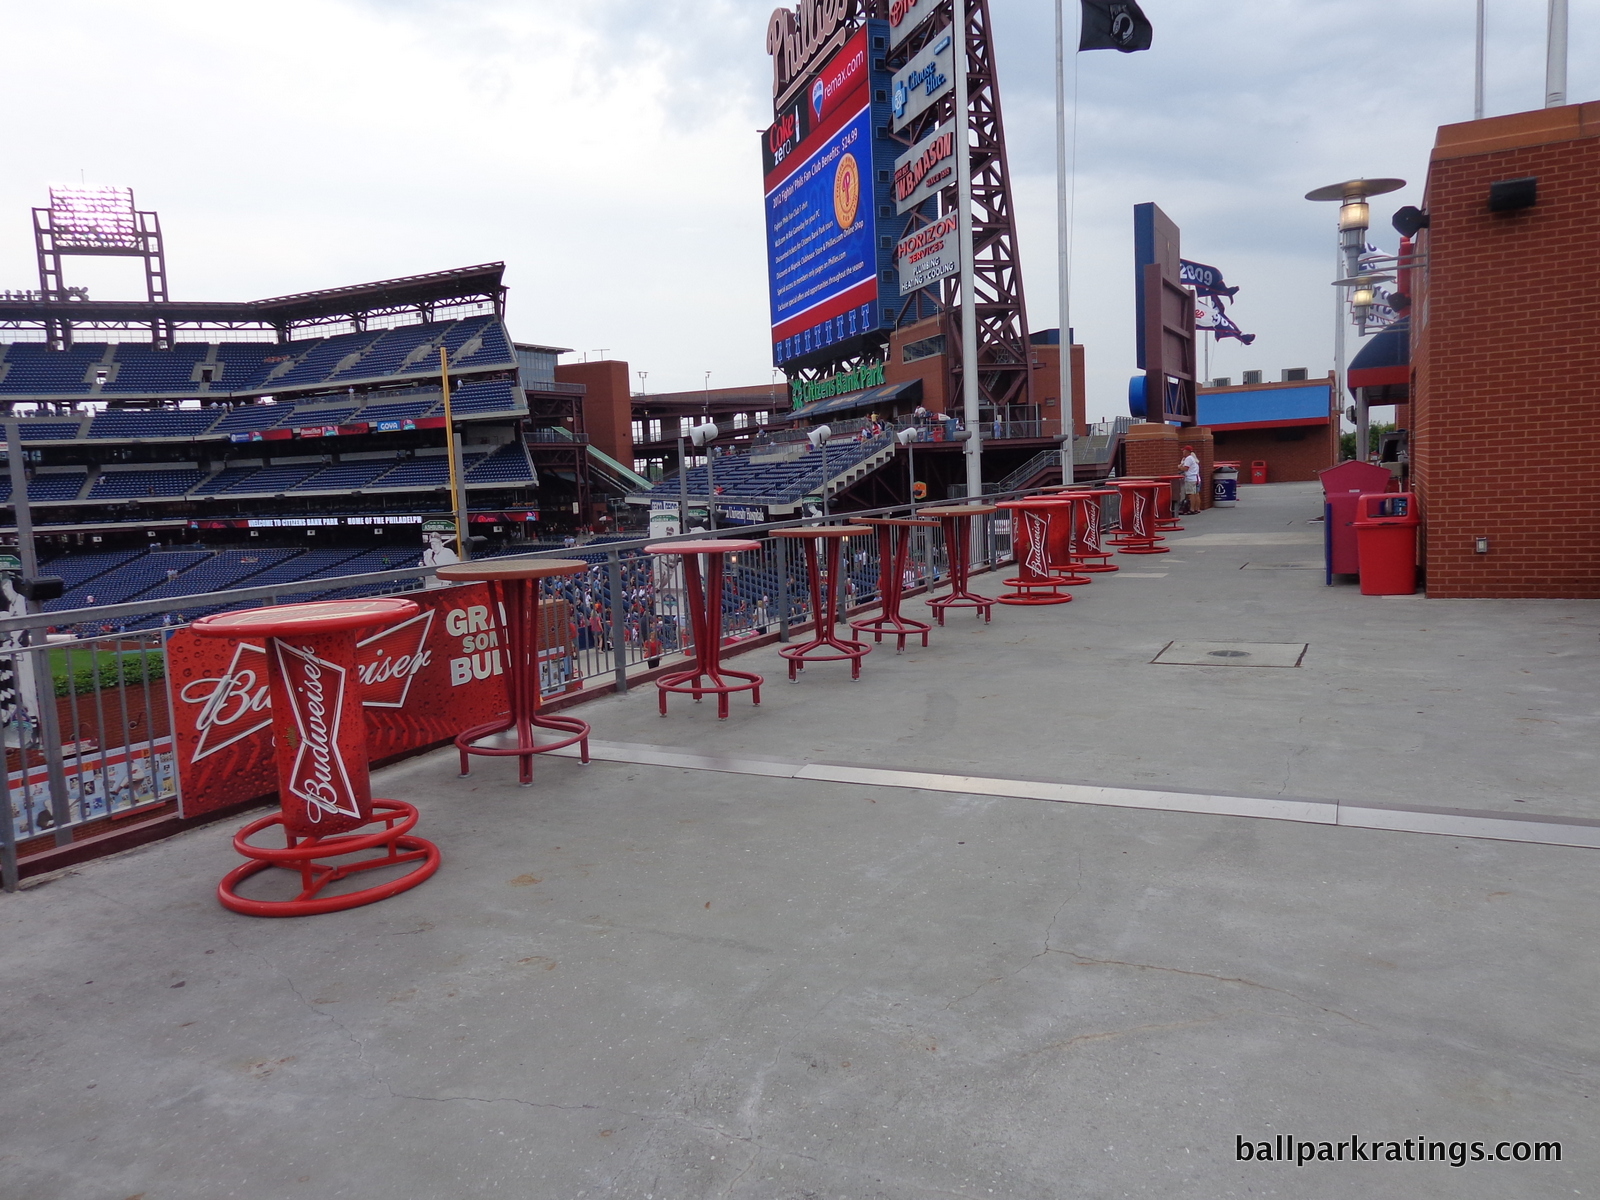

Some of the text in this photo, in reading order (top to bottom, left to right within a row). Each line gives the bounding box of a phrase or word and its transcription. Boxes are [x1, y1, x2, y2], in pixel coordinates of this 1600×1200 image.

[824, 50, 864, 100] remax.com
[908, 61, 936, 91] Choose
[770, 114, 794, 153] Coke
[812, 159, 821, 176] Club
[842, 127, 858, 151] $24.99
[898, 214, 957, 260] HORIZON
[908, 240, 944, 264] SERVICES
[927, 261, 955, 280] COOLING
[1180, 263, 1213, 286] 2009
[803, 378, 836, 403] Citizens
[836, 366, 861, 394] Bank
[861, 358, 885, 388] Park
[1031, 514, 1042, 577] Budweiser
[446, 601, 507, 637] GRA
[181, 646, 432, 731] Bueiser
[300, 645, 340, 824] Budweiser
